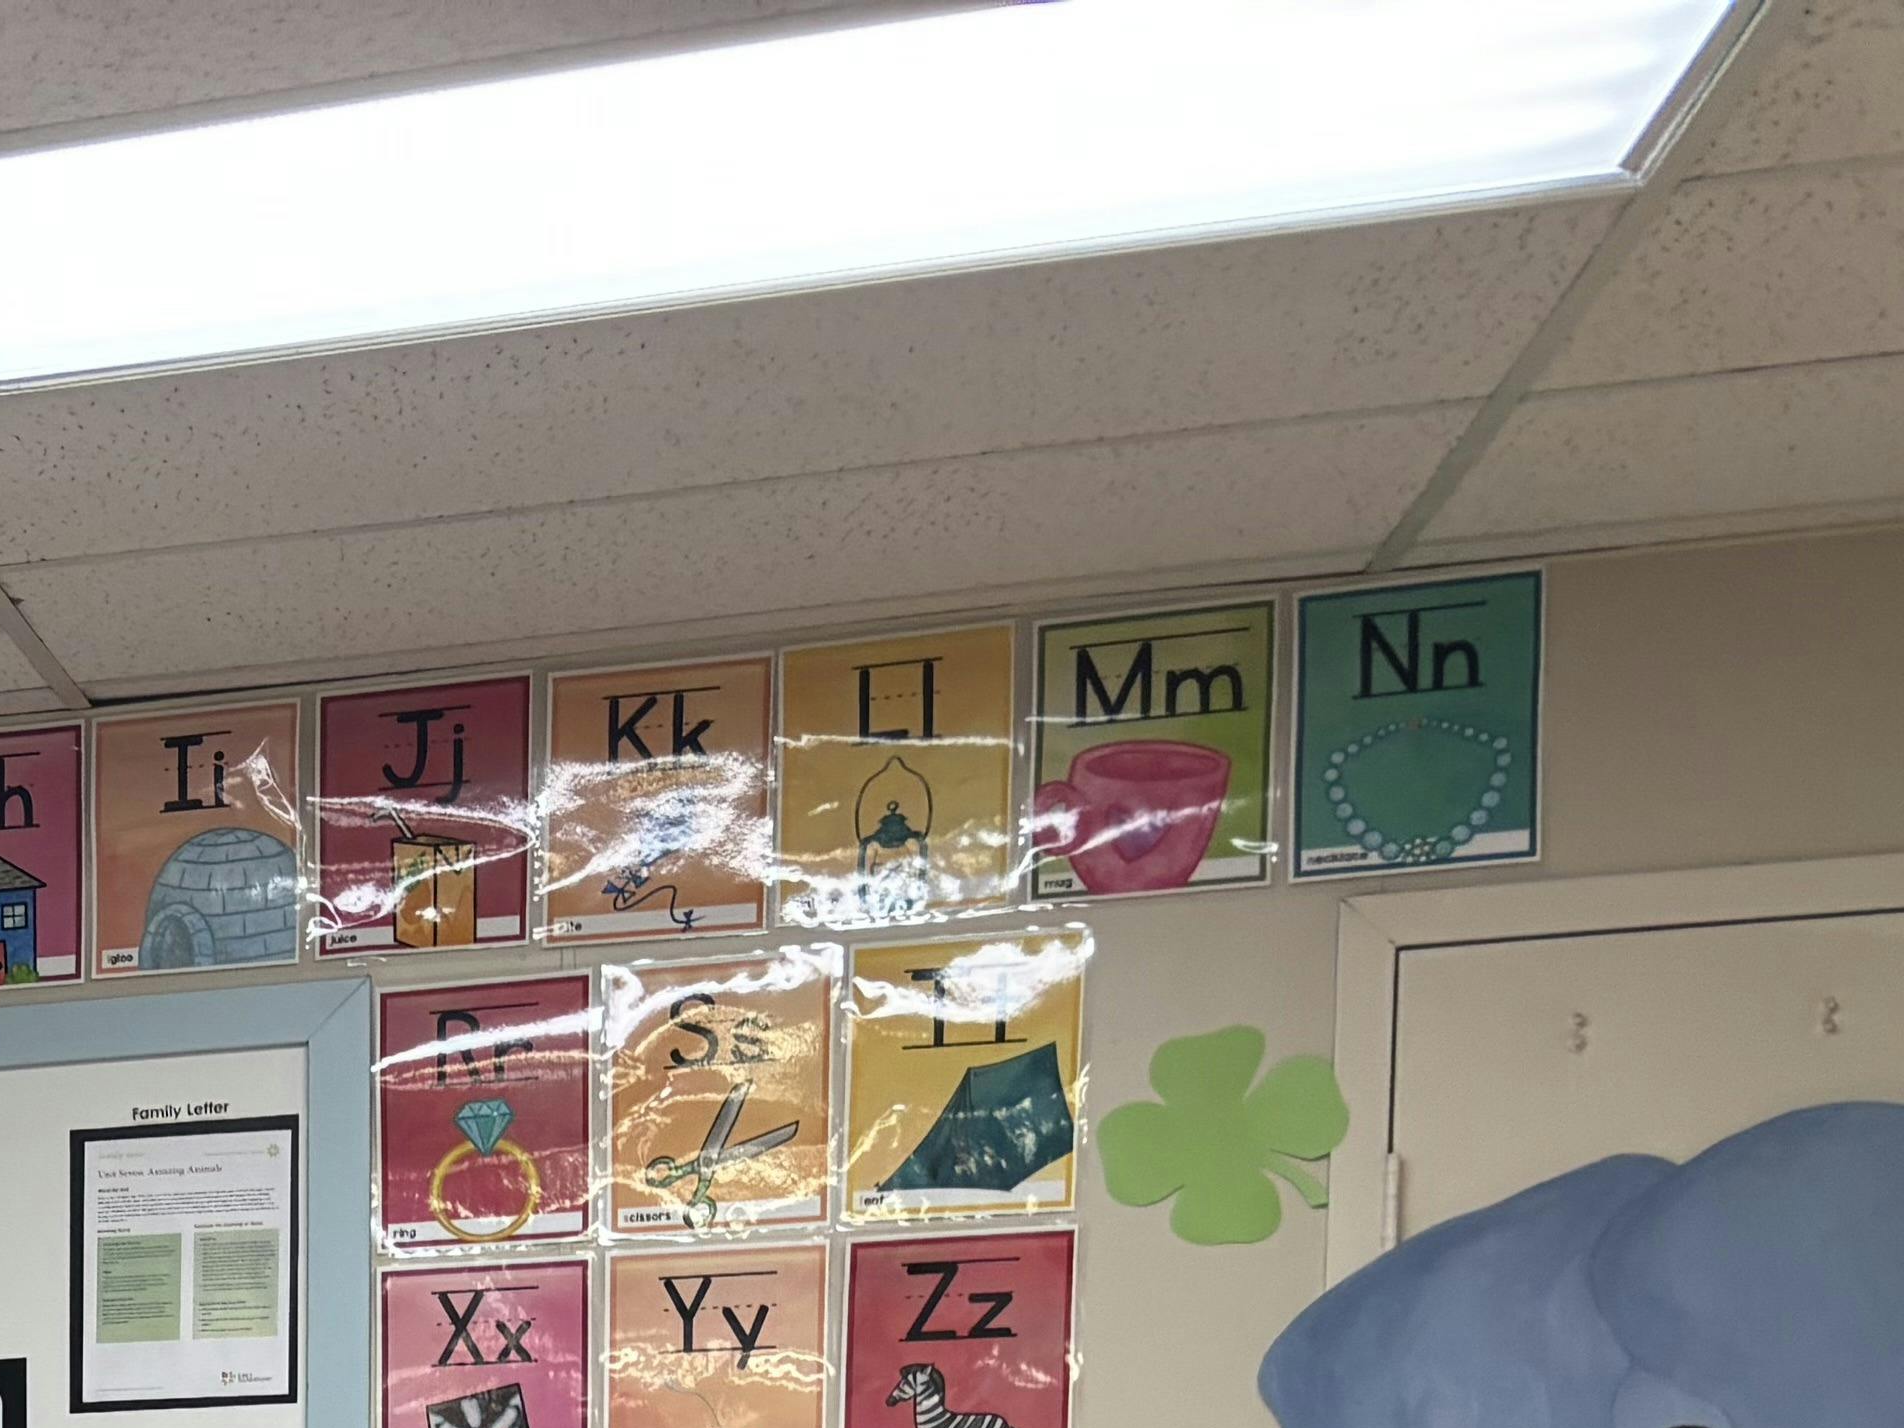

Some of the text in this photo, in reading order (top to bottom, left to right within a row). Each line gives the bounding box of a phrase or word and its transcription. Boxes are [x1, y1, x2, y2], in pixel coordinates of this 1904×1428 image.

[1076, 642, 1246, 723] Mm
[1358, 612, 1484, 697] Nn
[381, 709, 465, 804] Jj
[608, 688, 712, 767] Kk
[164, 735, 226, 811] Ii
[328, 931, 357, 948] juice
[131, 1101, 230, 1122] Family Letter
[392, 1227, 417, 1241] ring
[439, 1289, 534, 1367] Xx
[664, 1275, 770, 1370] Yy
[908, 1262, 1017, 1341] Zz
